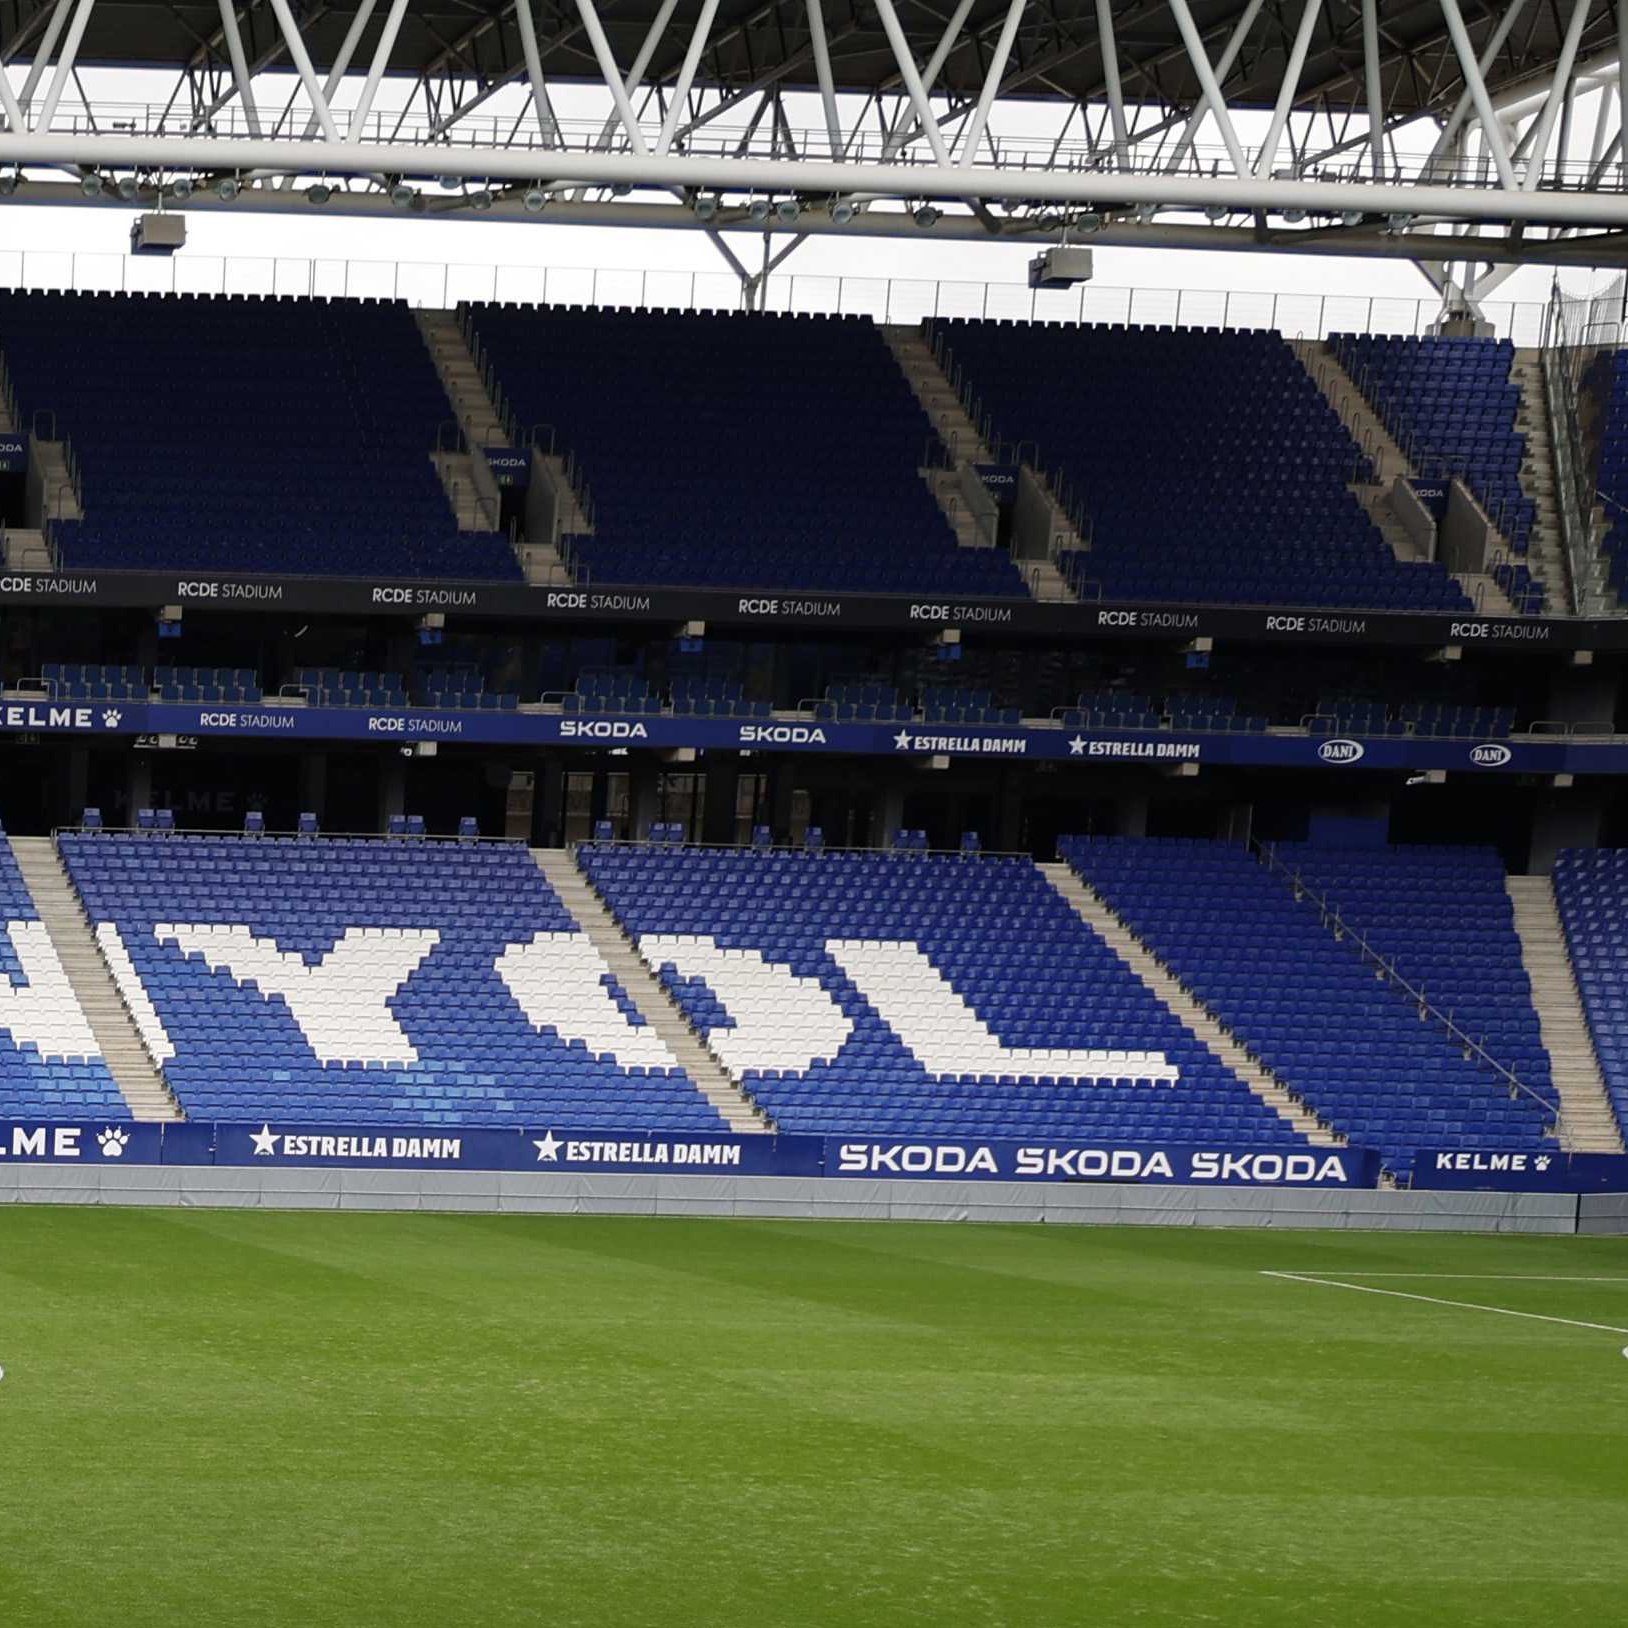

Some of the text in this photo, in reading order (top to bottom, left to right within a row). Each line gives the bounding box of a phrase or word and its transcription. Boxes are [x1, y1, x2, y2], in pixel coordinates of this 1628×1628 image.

[35, 578, 97, 593] STADIUM
[177, 581, 282, 599] RCDE STADIUM
[372, 587, 476, 605] RCDE STADIUM
[546, 592, 650, 610] RCDE STADIUM
[738, 598, 840, 616] RCDE STADIUM
[909, 604, 1011, 621] RCDE STADIUM
[1097, 610, 1198, 627] RCDE STADIUM
[1266, 615, 1365, 633] RCDE STADIUM
[1450, 622, 1549, 639] RCDE STADIUM
[200, 712, 294, 728] RCDE STADIUM
[368, 717, 462, 733] RCDE STADIUM
[560, 721, 648, 738] SKODA
[739, 726, 826, 744] SKODA
[914, 736, 1026, 753] ESTRELLA DAMM
[1088, 741, 1200, 758] ESTRELLA DAMM
[1323, 743, 1354, 758] DANI
[1474, 748, 1502, 762] DANI
[283, 1135, 461, 1159] ESTRELLA DAMM
[566, 1141, 741, 1165] ESTRELLA DAMM
[838, 1144, 1347, 1182] SKODA SKODA SKODA
[1436, 1153, 1527, 1171] KELME
